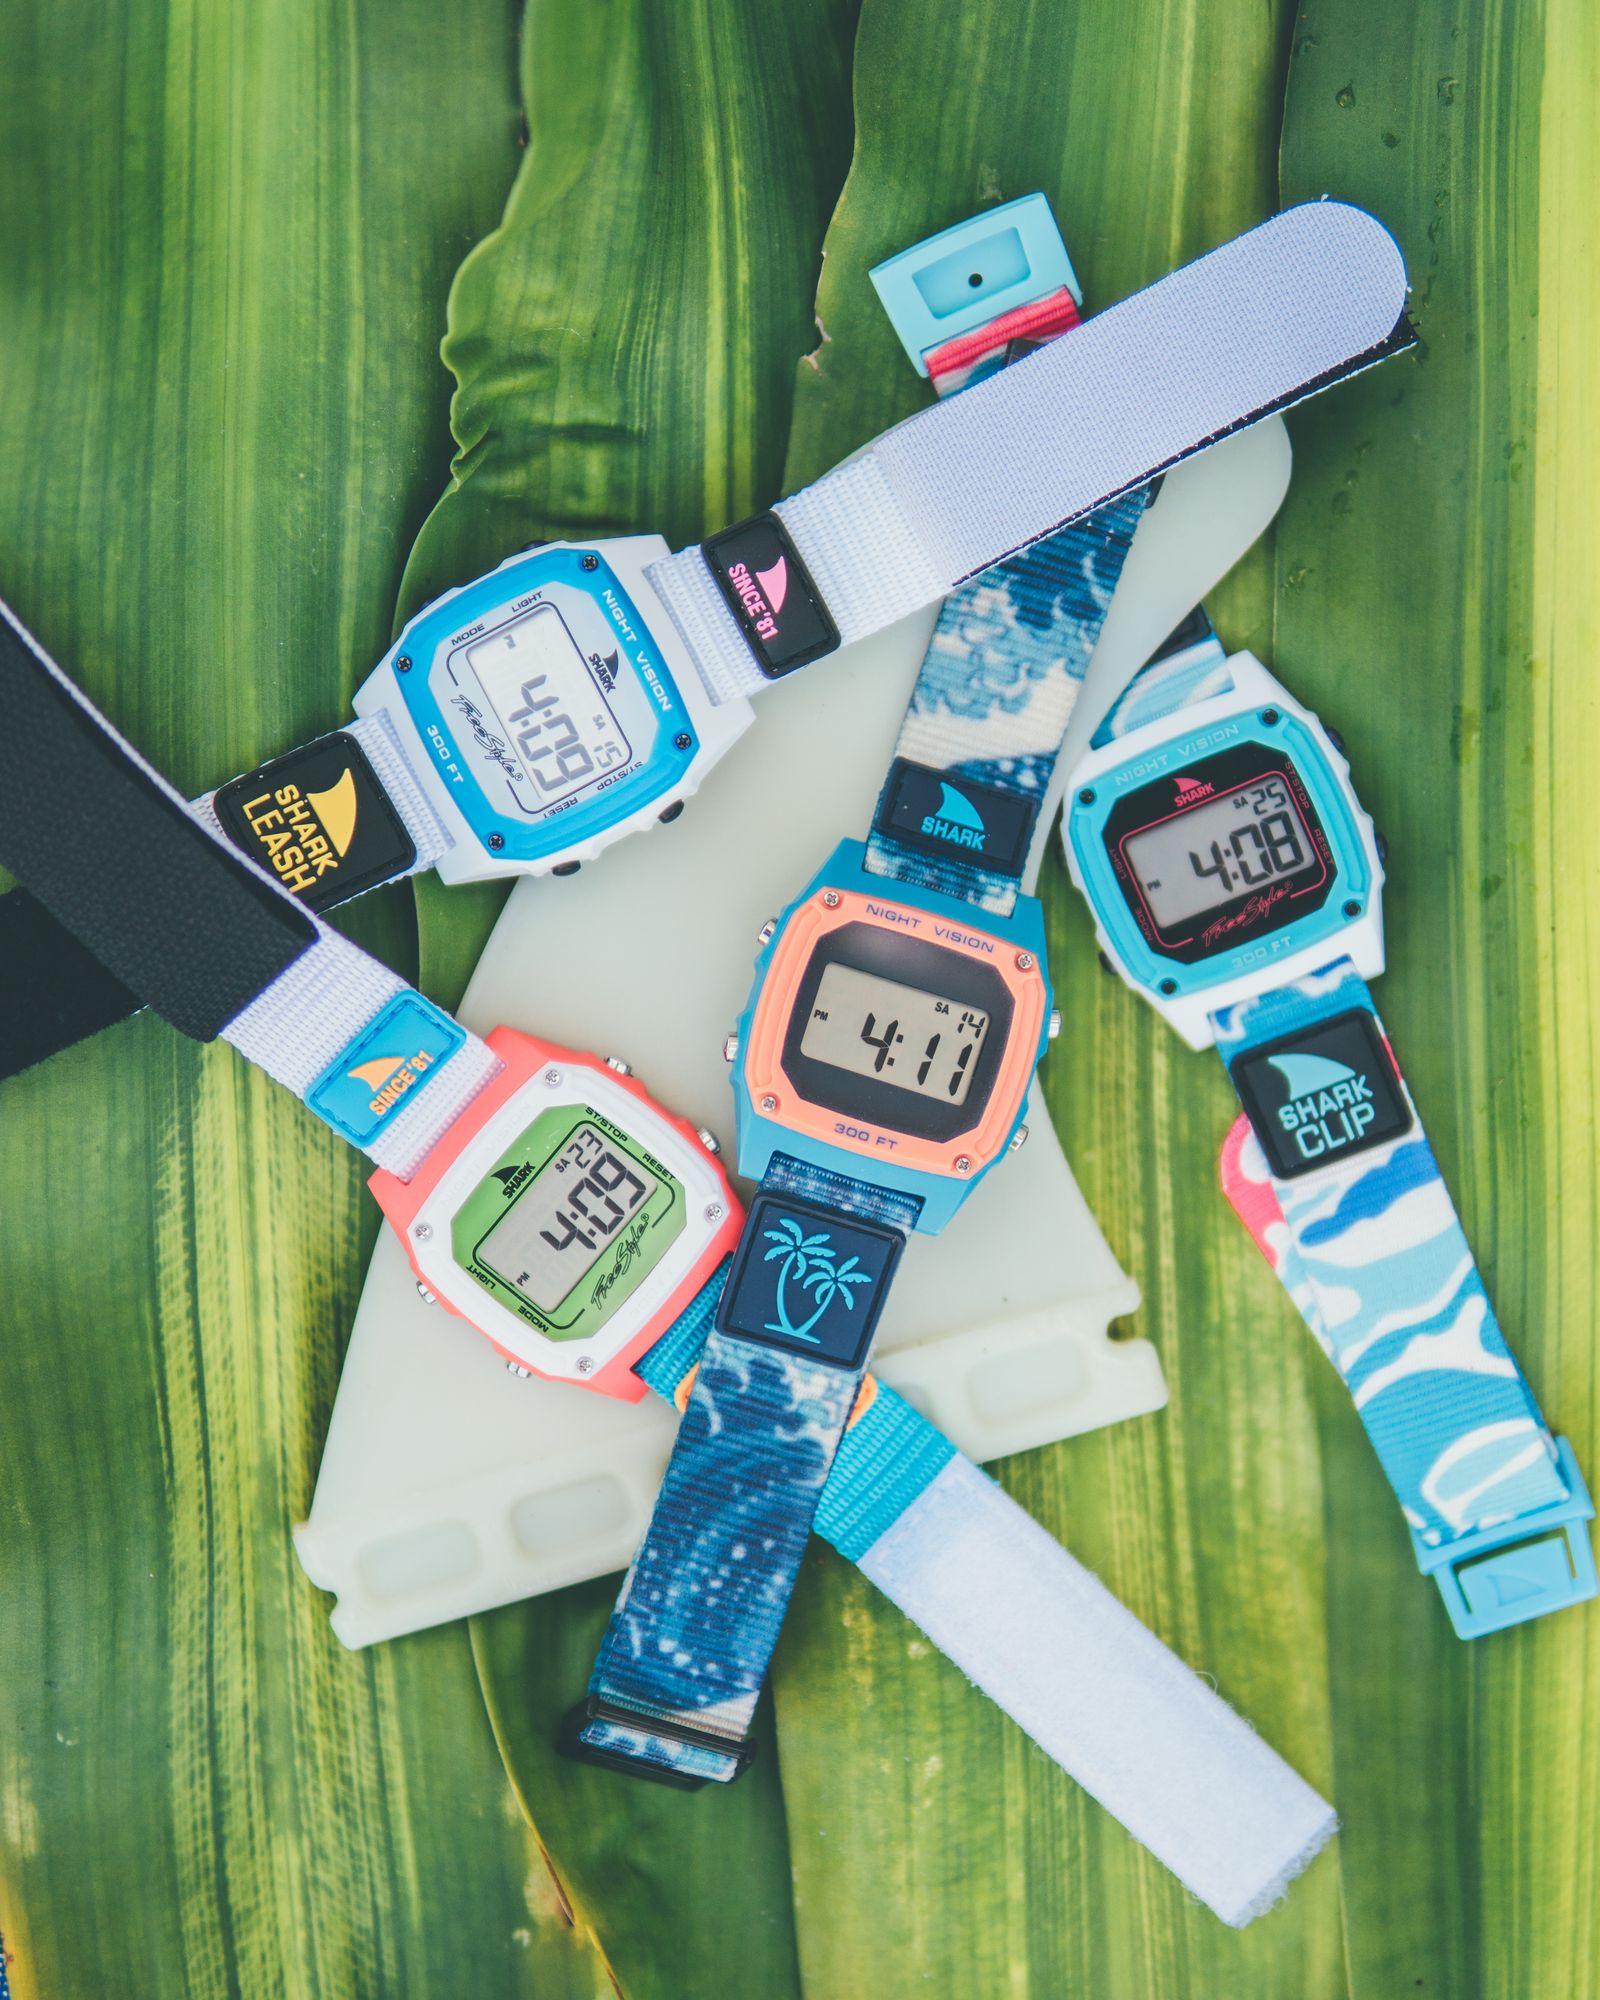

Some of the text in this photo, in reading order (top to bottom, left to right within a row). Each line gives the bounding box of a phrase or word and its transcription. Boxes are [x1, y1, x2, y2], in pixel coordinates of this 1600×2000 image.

[511, 591, 543, 612] LIGHT
[728, 563, 780, 640] SINCE '81
[451, 623, 485, 646] MODE
[602, 589, 673, 712] NIGHT VISION
[588, 653, 616, 694] SHARK
[508, 674, 595, 792] 4:09
[592, 714, 607, 731] SA
[426, 724, 464, 784] 300 FT
[594, 741, 623, 768] 15
[1114, 724, 1239, 786] NIGHT VISION
[597, 761, 644, 791] ST/STOP
[543, 797, 579, 818] RESET
[1174, 782, 1215, 808] SHARK
[1233, 797, 1248, 810] SA
[1253, 782, 1287, 816] 25
[242, 793, 317, 893] LEASH
[274, 784, 339, 877] SHARK
[920, 815, 986, 851] SHARK
[1314, 828, 1334, 865] RESET
[1189, 811, 1305, 893] 4:08
[866, 903, 995, 953] NIGHT VISION
[1232, 936, 1291, 969] 300 FT
[813, 1008, 829, 1022] PM
[934, 1001, 950, 1015] SA
[958, 1011, 986, 1039] 14
[860, 1012, 973, 1097] 4:11
[369, 1049, 434, 1116] SINCE '81
[1278, 1075, 1374, 1131] SHARK
[585, 1106, 629, 1142] ST/STOP
[833, 1123, 898, 1151] 300 FT
[1295, 1102, 1375, 1159] CLIP
[555, 1158, 571, 1173] SA
[566, 1129, 603, 1169] 23
[502, 1161, 536, 1199] SHARK
[642, 1153, 677, 1182] RESET
[539, 1151, 647, 1251] 4:09
[466, 1265, 497, 1290] LIGHT
[516, 1271, 530, 1287] PM
[517, 1305, 550, 1333] MODE
